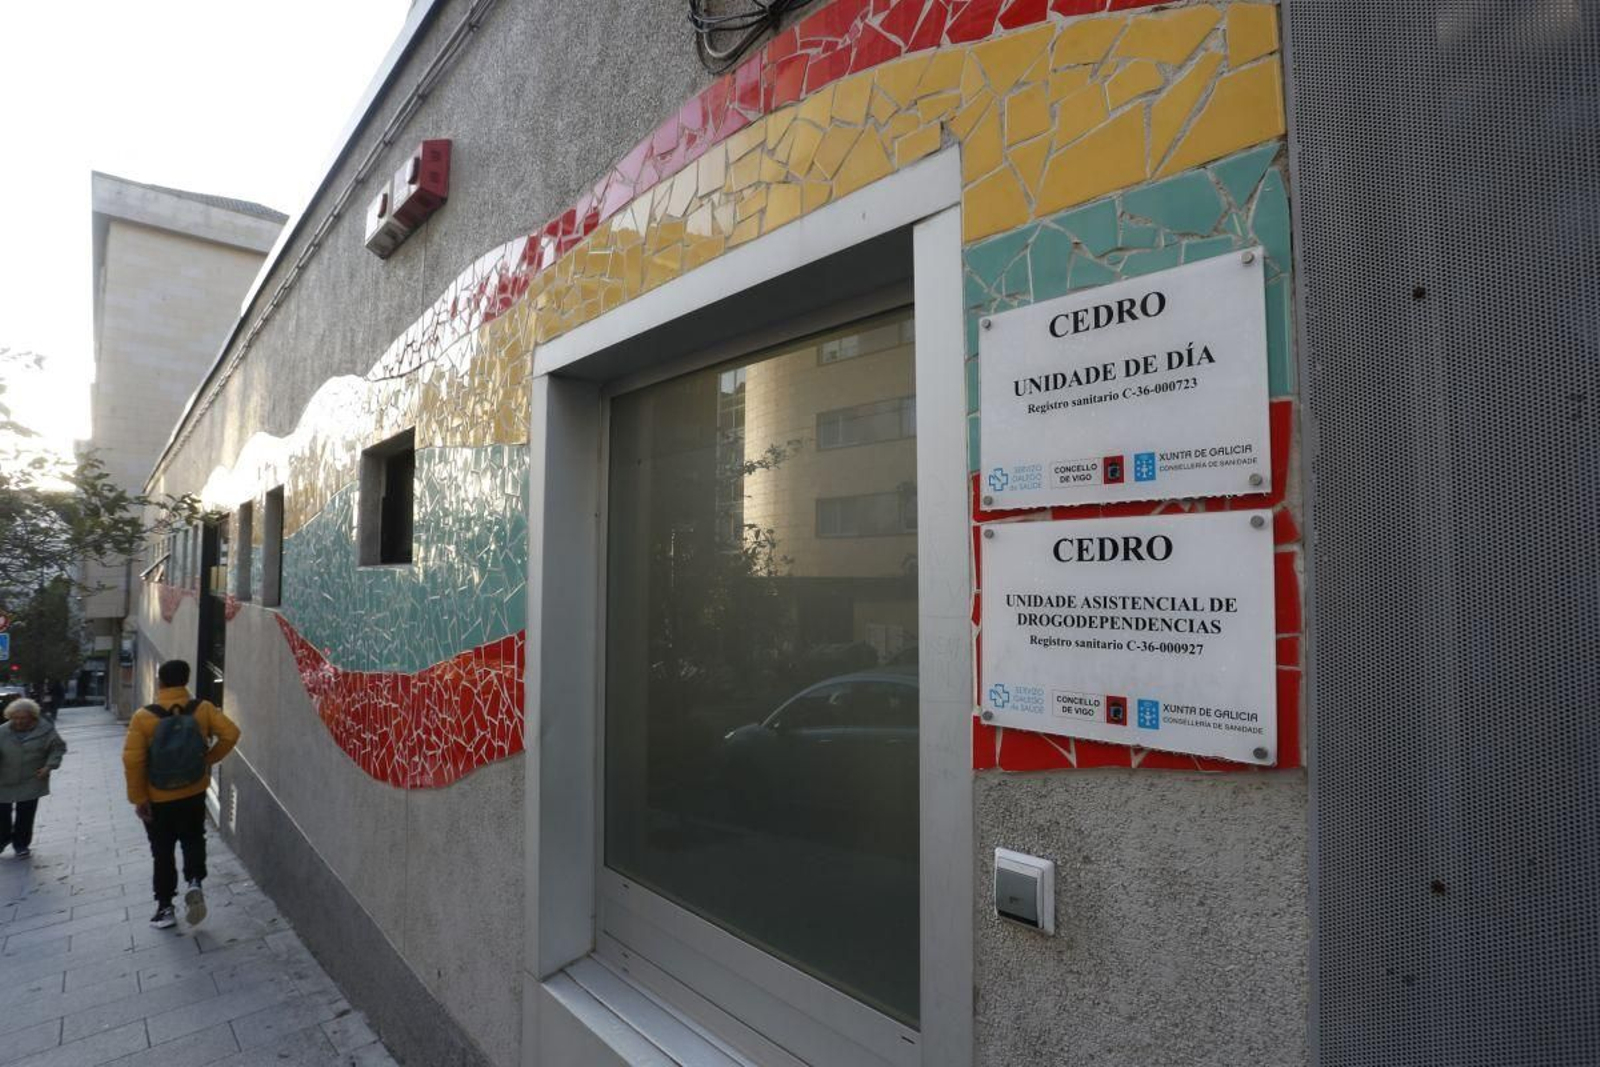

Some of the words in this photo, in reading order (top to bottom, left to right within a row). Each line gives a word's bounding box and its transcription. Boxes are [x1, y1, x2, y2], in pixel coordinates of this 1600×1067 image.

[1049, 291, 1167, 338] CEDRO
[1014, 362, 1116, 397] UNIDADE
[1123, 355, 1158, 377] DE
[1167, 342, 1216, 370] DÍA
[1027, 399, 1069, 414] Registro
[1072, 391, 1119, 407] sanitario
[1122, 378, 1198, 399] C-36-000723
[1159, 450, 1191, 461] XUNTA
[1194, 449, 1208, 458] DE
[1209, 444, 1252, 456] GALICIA
[1220, 457, 1257, 466] SANIDADE
[1054, 463, 1097, 473] CONCELLO
[1073, 473, 1092, 482] VIGO
[1053, 535, 1173, 562] CEDRO
[1006, 594, 1076, 609] UNIDADE
[1081, 596, 1204, 613] ASISTENCIAL
[1209, 598, 1238, 613] DE
[1017, 613, 1222, 634] DROGODEPENDENCIAS
[1030, 635, 1072, 648] Registro
[1075, 639, 1123, 651] sanitario
[1126, 640, 1204, 656] C-36-000927
[1056, 696, 1100, 707] CONCELLO
[1062, 706, 1073, 714] DE
[1075, 708, 1094, 716] VIGO
[1163, 703, 1197, 716] XUNTA
[1199, 707, 1212, 717] DE
[1214, 709, 1258, 722] GALICIA
[1212, 722, 1223, 730] DE
[1224, 724, 1263, 735] SANIDADE
